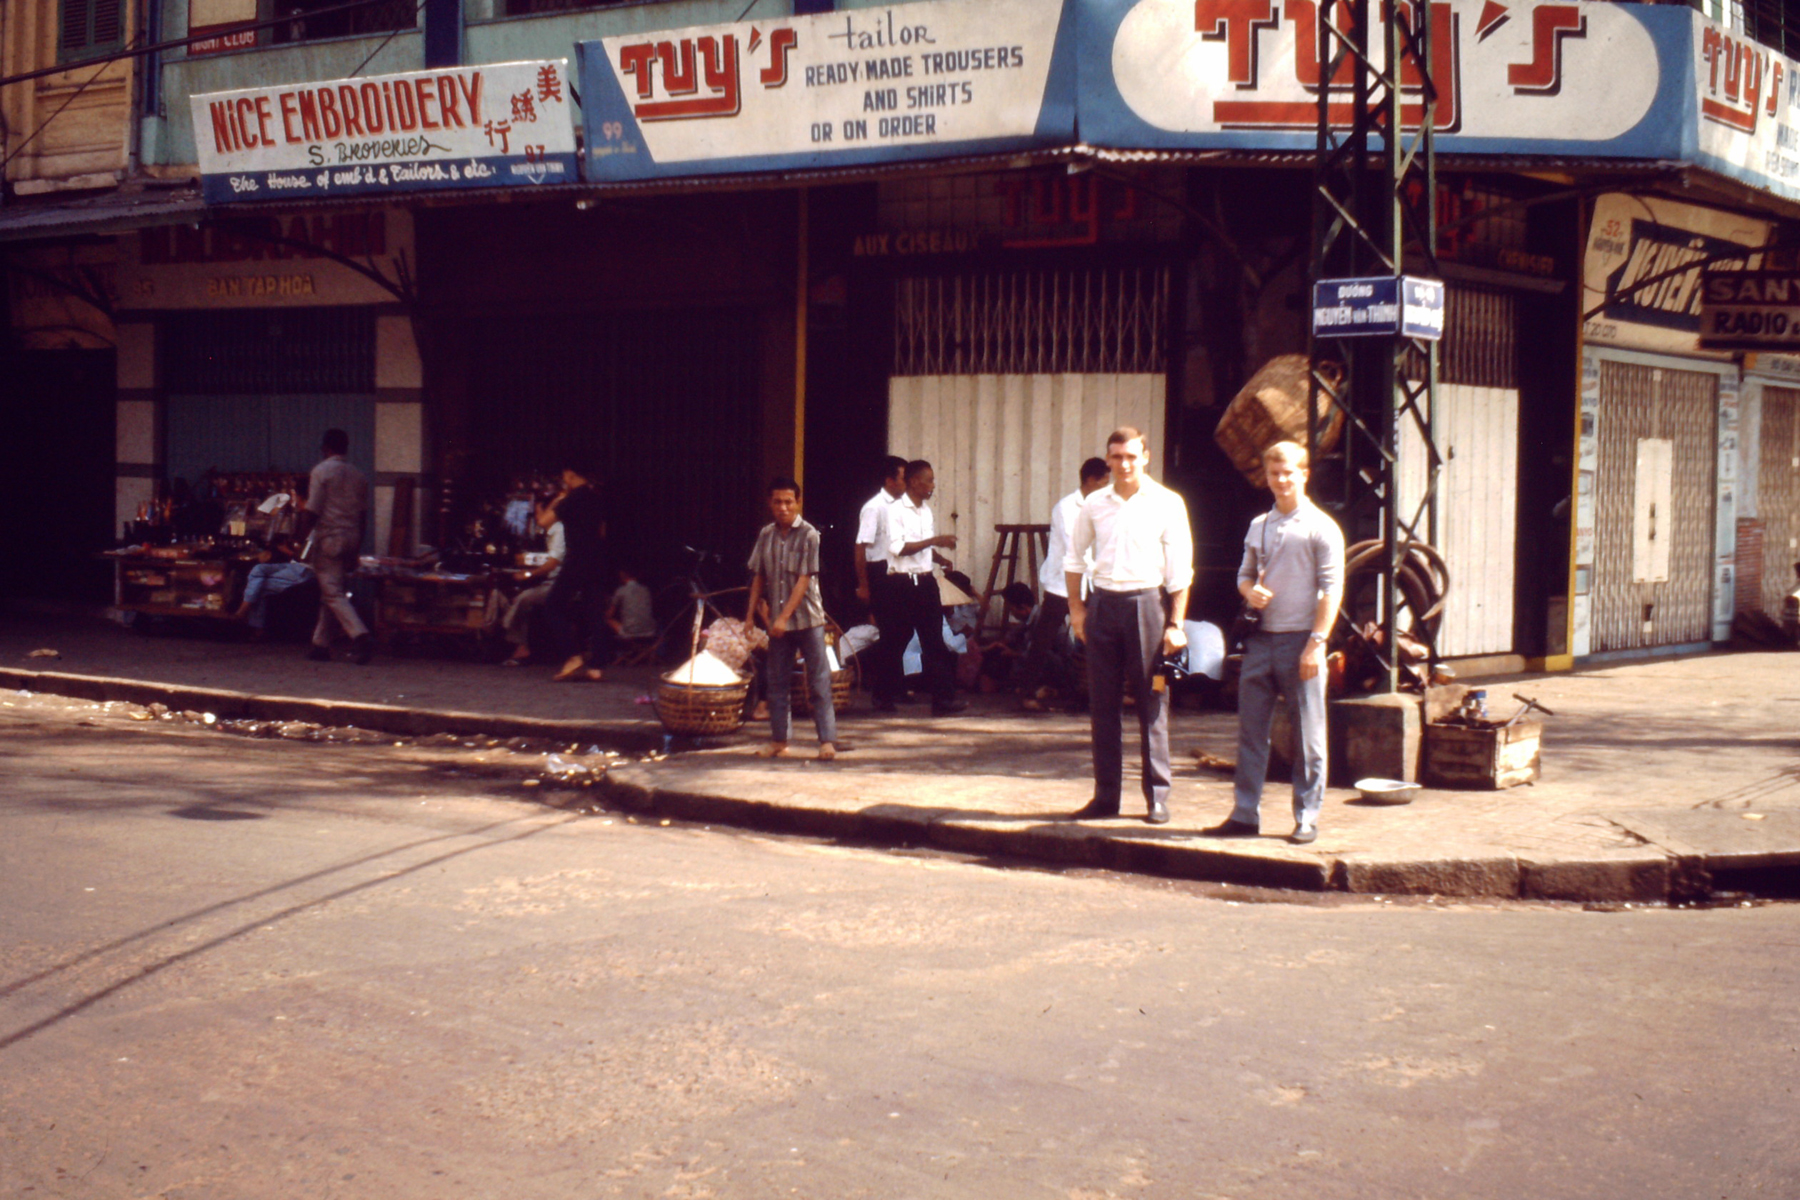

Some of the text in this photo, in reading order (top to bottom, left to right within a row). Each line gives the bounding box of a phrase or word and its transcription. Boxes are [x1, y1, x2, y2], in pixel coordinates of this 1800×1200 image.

[223, 30, 255, 47] CLUB
[828, 10, 936, 51] tailor
[805, 45, 1024, 88] READY MADE TROUSERS
[862, 88, 898, 112] AND
[811, 112, 936, 143] OR ON ORDER
[525, 144, 545, 164] 97
[267, 171, 312, 190] House
[316, 169, 330, 190] of
[378, 167, 389, 186] &
[450, 163, 461, 181] &
[852, 234, 890, 257] AUX
[1713, 310, 1788, 336] RADIO
